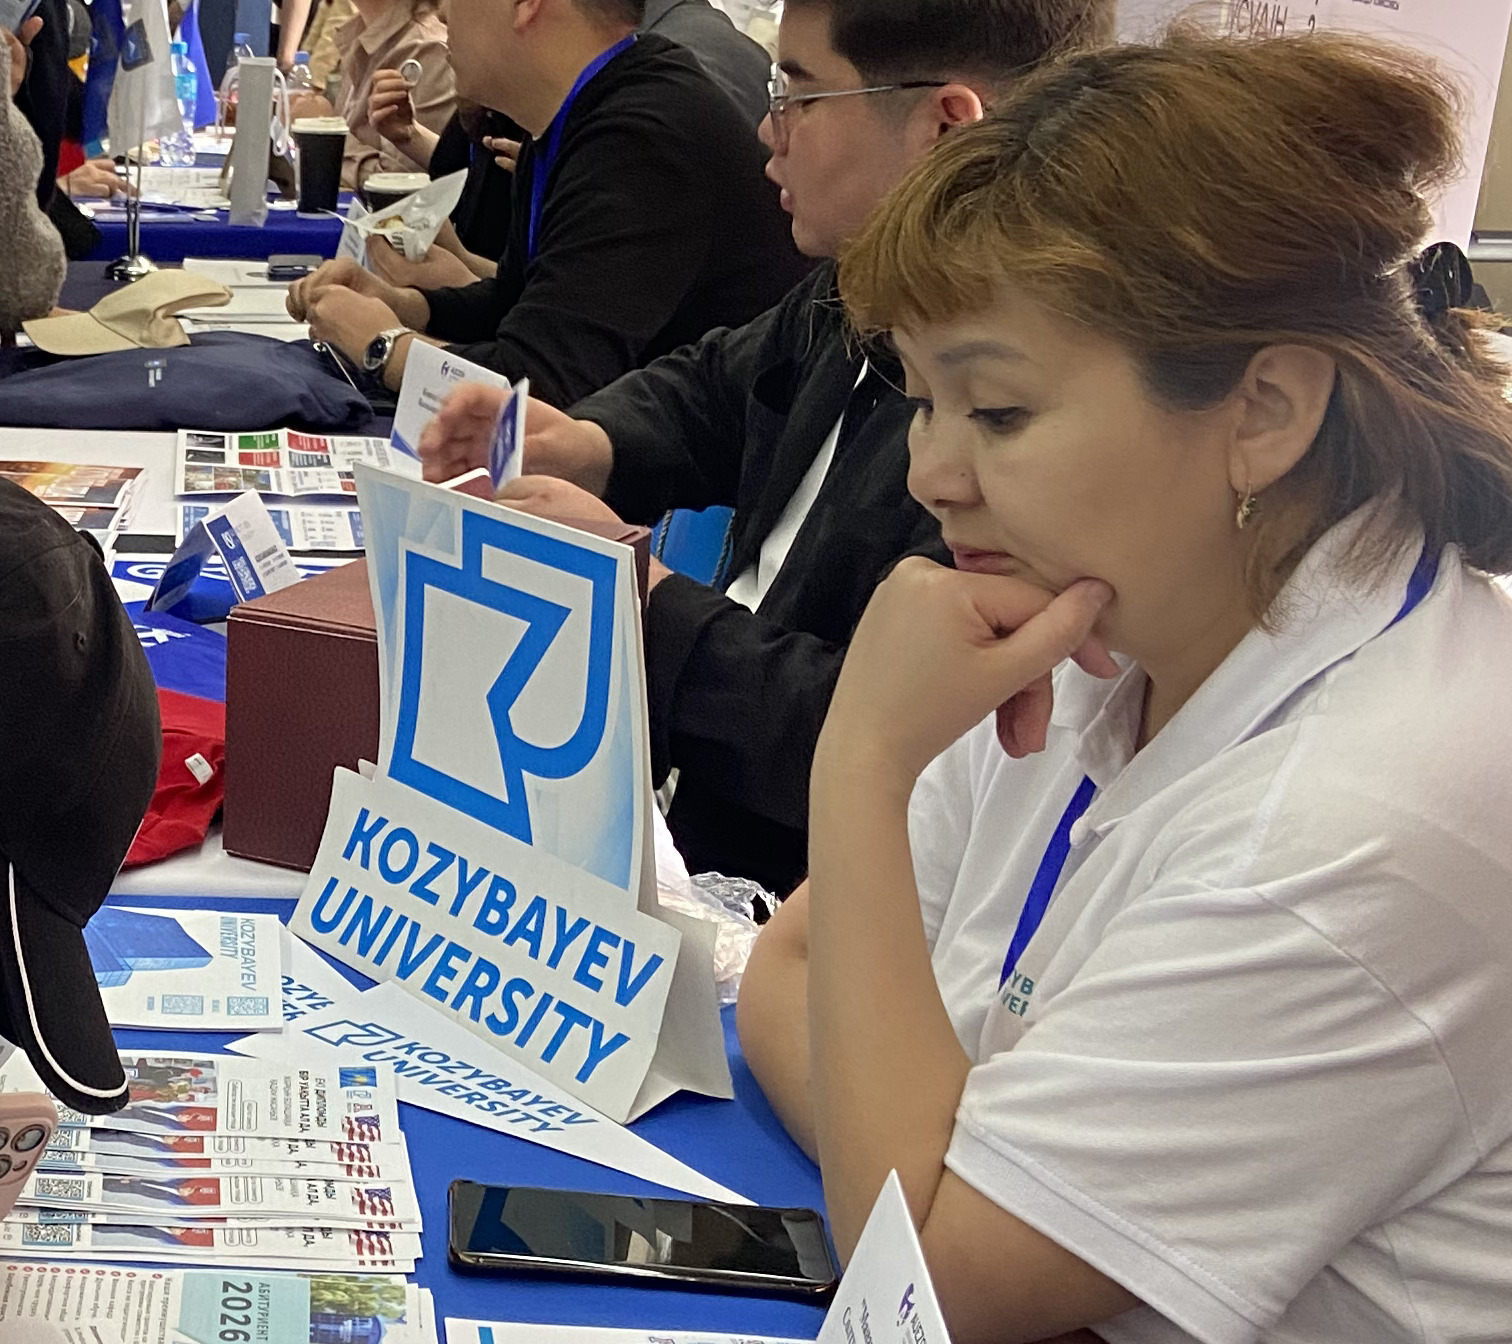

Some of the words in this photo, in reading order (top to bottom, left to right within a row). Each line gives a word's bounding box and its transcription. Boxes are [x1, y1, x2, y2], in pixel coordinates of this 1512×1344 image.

[341, 808, 663, 1007] KOZYBAYEV
[240, 918, 257, 991] KOZYBAYEV
[311, 877, 630, 1084] UNIVERSITY
[362, 1051, 566, 1134] UNIVERSITY
[397, 1039, 598, 1127] KOZYBAYEV
[219, 1281, 252, 1342] 2026
[256, 1282, 270, 1341] АБИТУРИЕНТ
